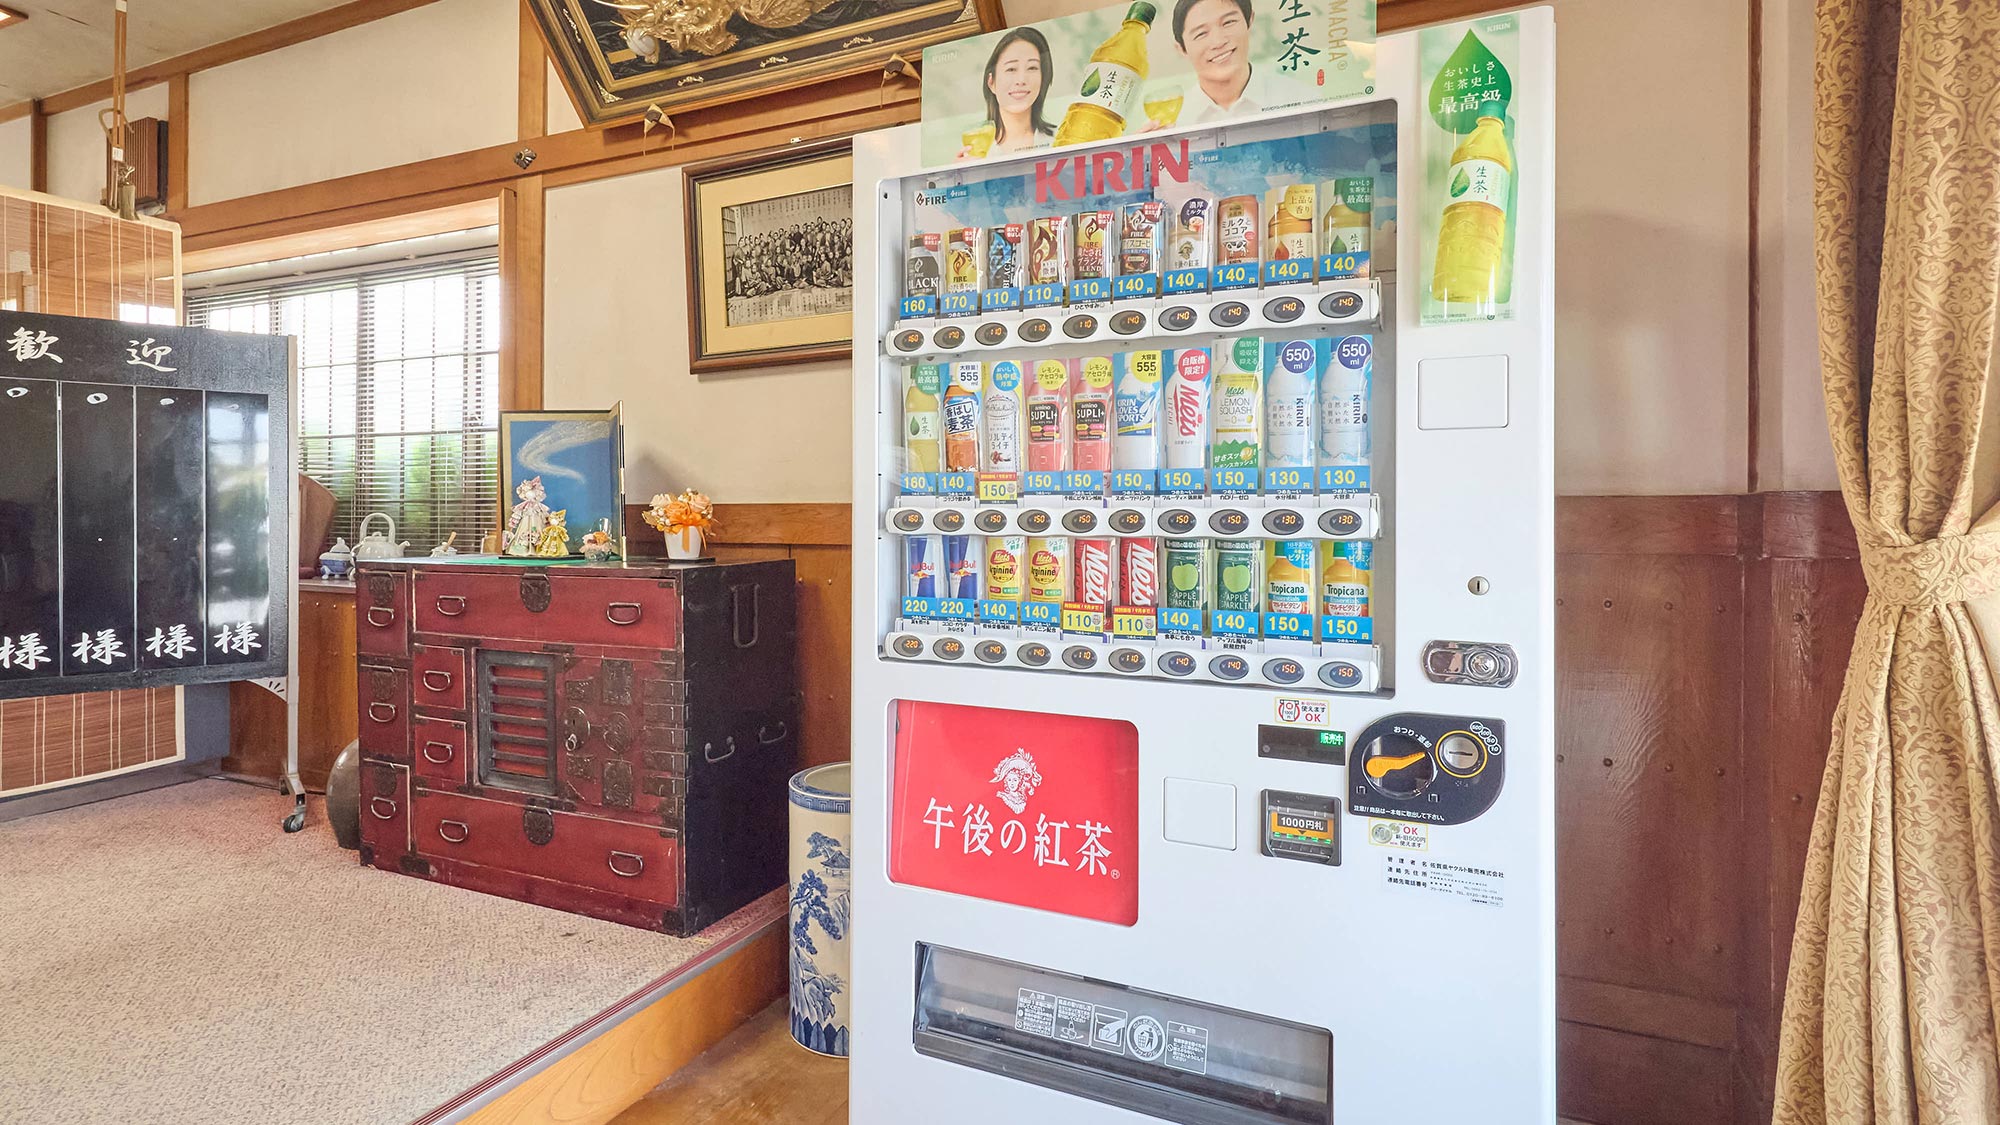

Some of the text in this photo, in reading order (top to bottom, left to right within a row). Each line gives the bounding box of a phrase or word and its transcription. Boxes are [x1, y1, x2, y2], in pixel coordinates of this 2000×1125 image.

[1445, 61, 1495, 77] おいしさ
[1100, 70, 1118, 99] 生茶
[1444, 74, 1496, 91] 生茶史上
[1438, 89, 1502, 114] 最高級
[1034, 139, 1190, 203] KIRIN
[1473, 166, 1488, 193] 生茶
[925, 195, 947, 206] FIRE
[1290, 196, 1312, 204] 上品な
[1296, 206, 1309, 214] 香り
[1222, 218, 1251, 228] ミルクと
[1225, 226, 1248, 236] ココア
[1282, 302, 1296, 311] 140
[1340, 297, 1353, 306] 140
[1177, 312, 1190, 320] 140
[1228, 307, 1241, 316] 140
[1128, 316, 1139, 324] 140
[1239, 340, 1258, 348] 脂肪の
[1239, 349, 1258, 357] 吸収を
[1342, 343, 1367, 357] 550
[1182, 354, 1205, 367] 自販機
[1286, 349, 1310, 362] 550
[1239, 357, 1258, 366] 抑える
[1293, 361, 1303, 370] ml
[1350, 358, 1360, 366] ml
[1137, 361, 1157, 373] 555
[1184, 365, 1204, 376] 限定!
[960, 371, 979, 382] 555
[1220, 397, 1250, 407] LEMON
[1180, 384, 1200, 437] Mets
[1219, 406, 1252, 416] SQUASH
[1296, 397, 1304, 427] KIRIN
[948, 418, 974, 431] 麦茶
[1034, 515, 1045, 523] 150
[1079, 515, 1091, 523] 150
[1126, 515, 1138, 523] 150
[1176, 515, 1189, 523] 150
[1228, 515, 1241, 524] 150
[1282, 515, 1296, 525] 130
[1339, 515, 1353, 525] 130
[1086, 544, 1108, 604] Mets
[1132, 542, 1155, 606] Mets
[1270, 582, 1305, 594] Tropicana
[1327, 584, 1364, 596] Tropicana
[1175, 591, 1196, 600] APPLE
[1226, 592, 1249, 601] APPLE
[1272, 601, 1301, 610] マルチビタミン
[1329, 604, 1361, 612] マルチビタミン
[145, 624, 197, 659] 様
[214, 622, 262, 655] 様
[0, 632, 51, 670] 様
[71, 628, 127, 665] 様
[946, 643, 959, 651] 220
[1176, 658, 1189, 666] 140
[1227, 661, 1241, 670] 140
[1282, 664, 1296, 674] 150
[1339, 668, 1353, 677] 150
[1301, 705, 1326, 713] 使えます
[1305, 713, 1321, 722] OK
[1320, 732, 1344, 746] 販売中
[1281, 816, 1324, 831] 1000円札
[1403, 826, 1418, 836] OK
[1400, 840, 1422, 848] 使えます
[1430, 862, 1505, 879] 佐賀県ヤクルト販売株式会社
